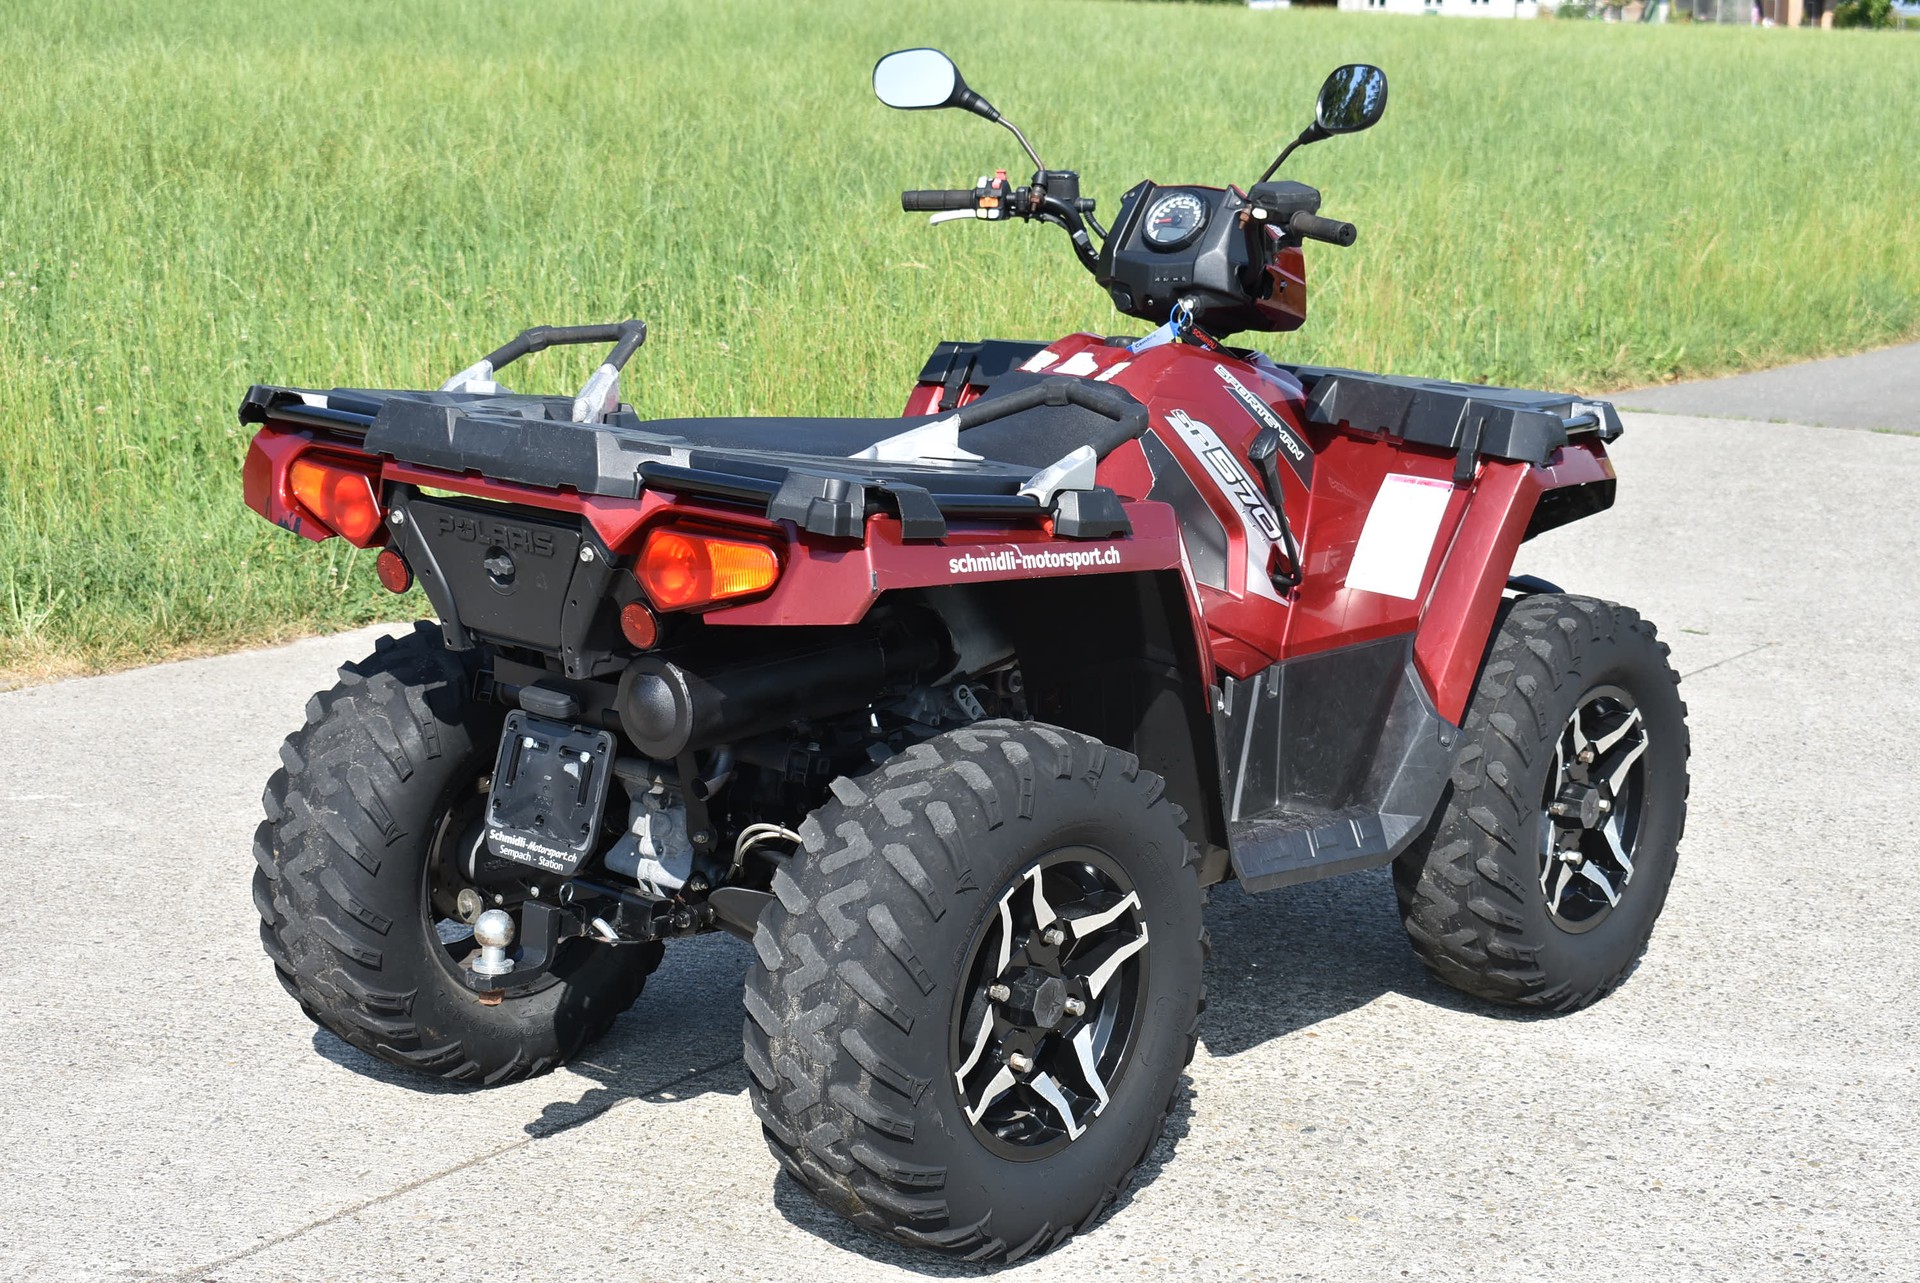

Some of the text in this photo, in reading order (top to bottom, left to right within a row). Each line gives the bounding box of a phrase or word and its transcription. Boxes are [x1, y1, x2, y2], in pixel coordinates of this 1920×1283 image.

[1214, 363, 1306, 462] SPORTSMAN
[1202, 446, 1284, 541] 570
[438, 512, 555, 557] POLARIS
[949, 545, 1121, 574] schmidli-motorsport.ch
[489, 828, 578, 863] Schmidli-Motorsport.ch
[499, 844, 532, 861] Sempach
[538, 855, 564, 871] Station
